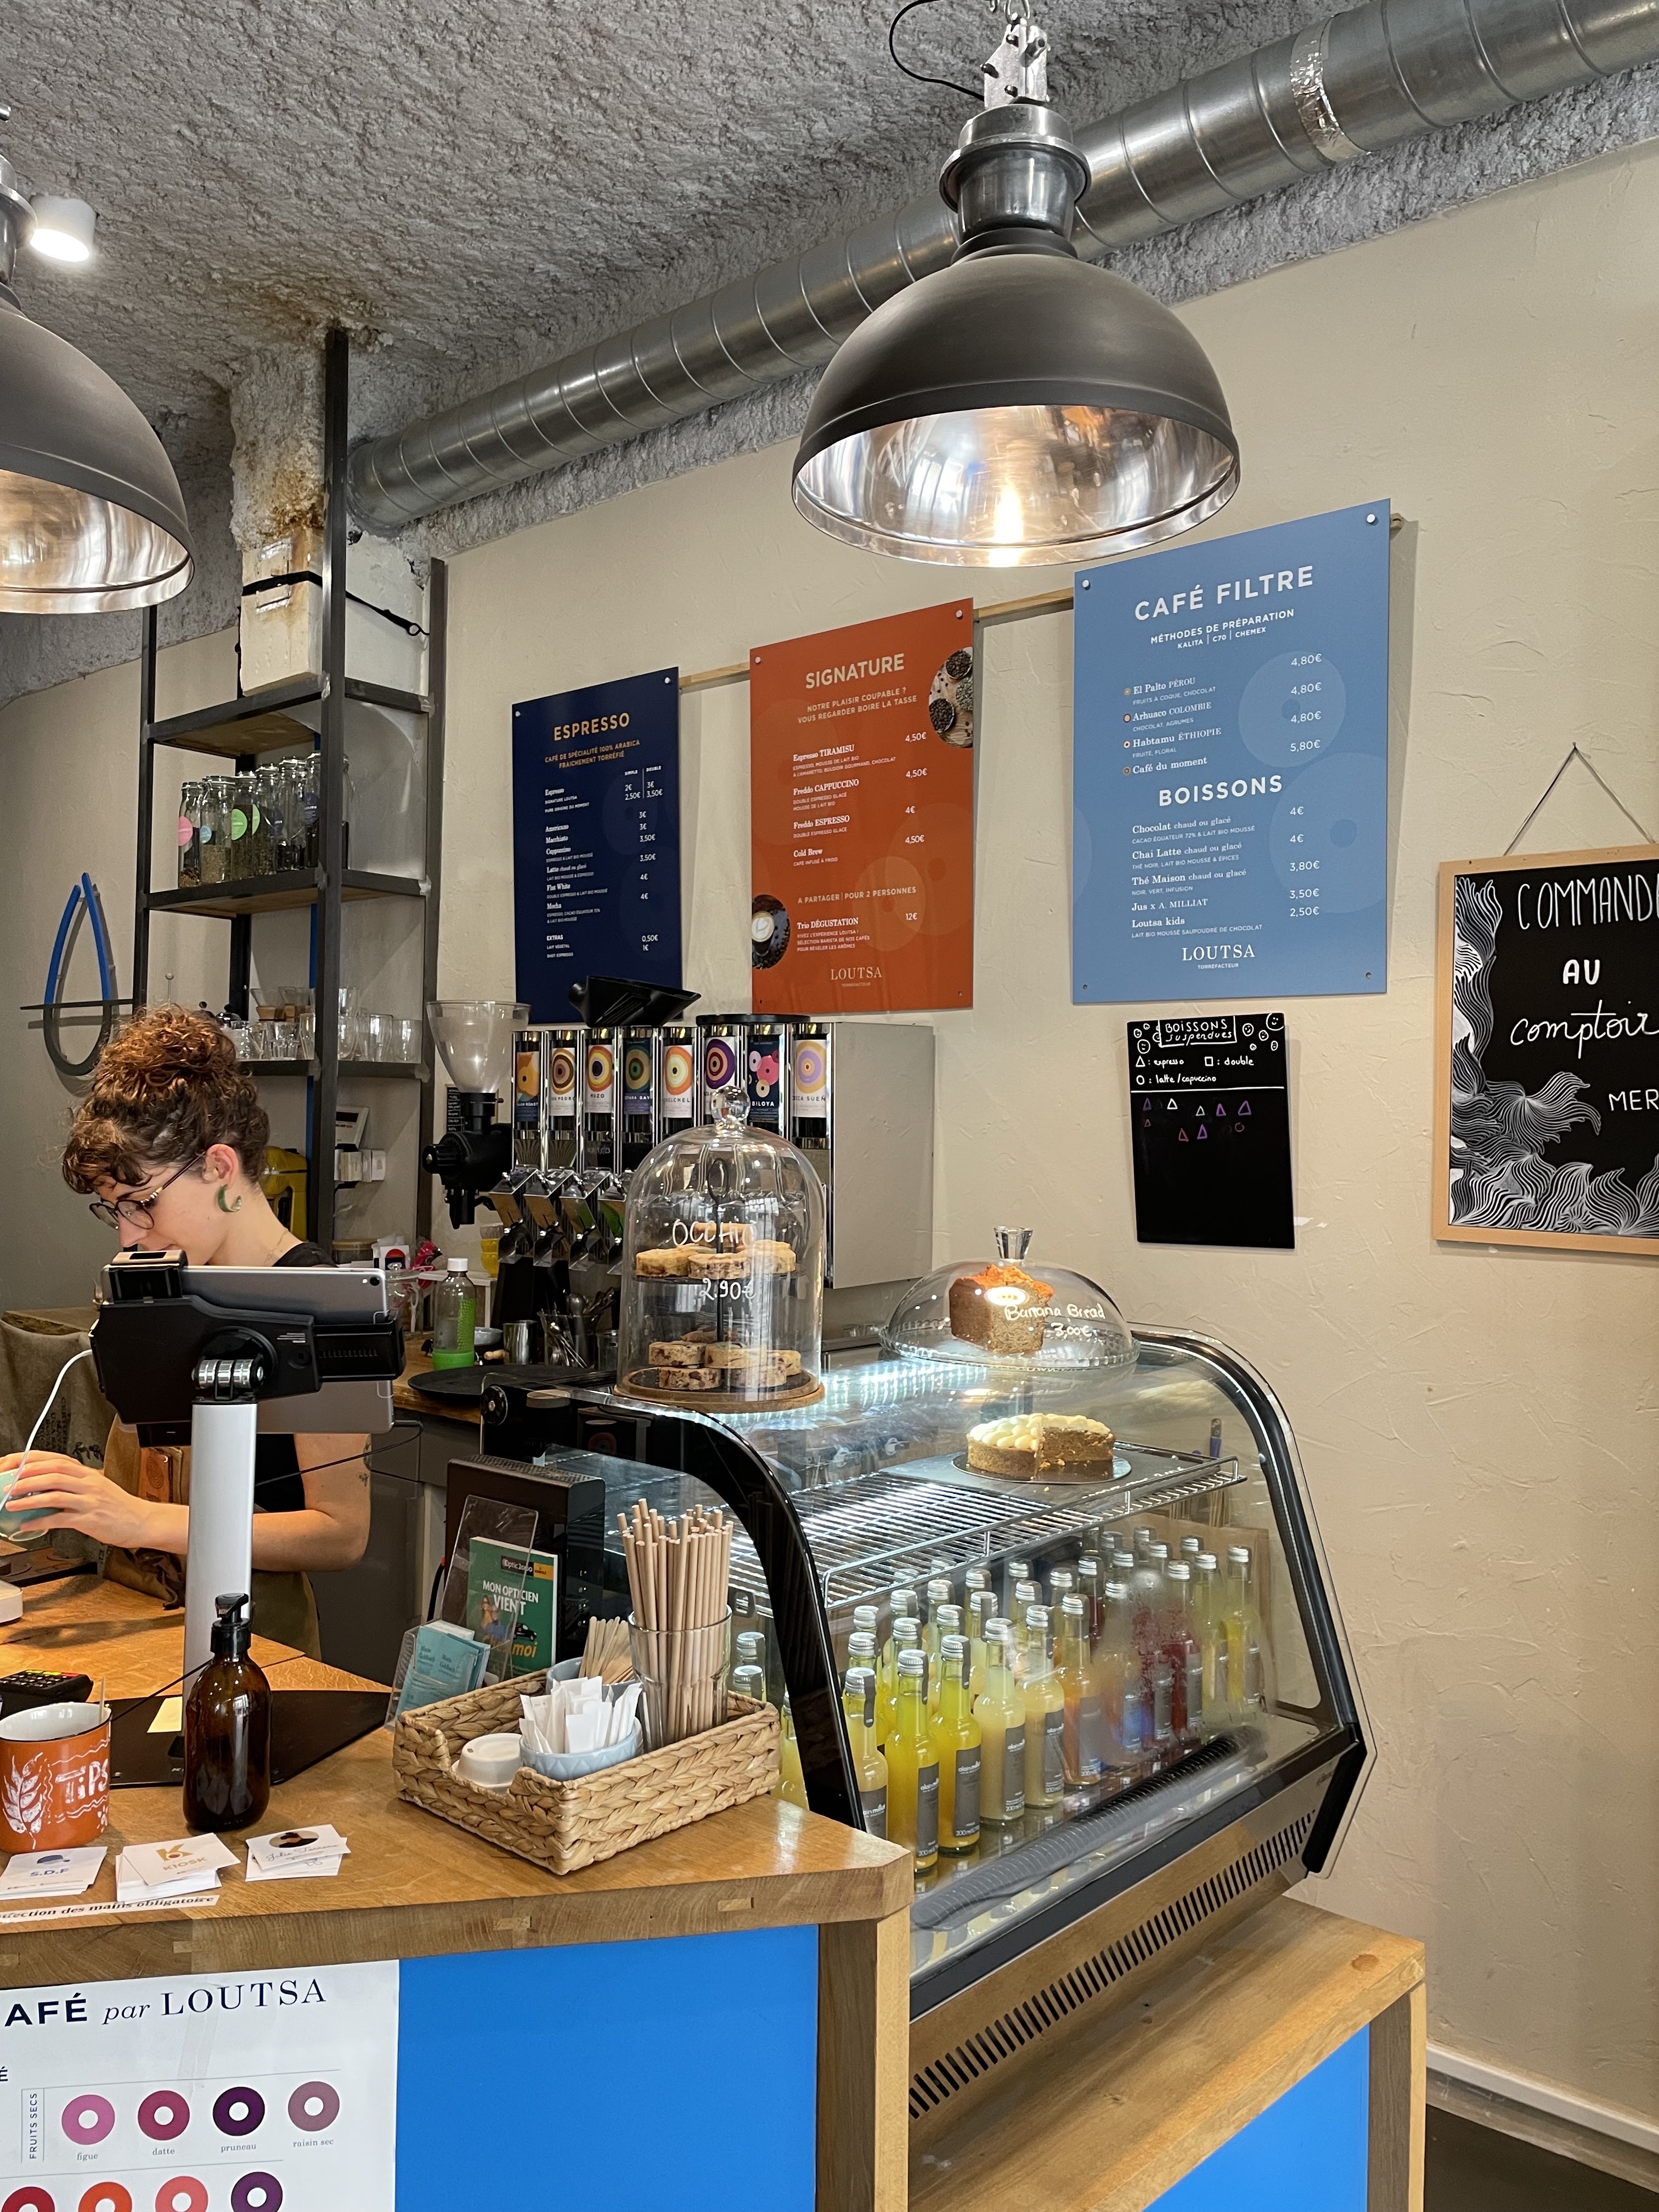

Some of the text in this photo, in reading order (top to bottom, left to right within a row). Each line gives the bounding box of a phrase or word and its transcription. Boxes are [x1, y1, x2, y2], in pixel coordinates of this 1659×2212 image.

[1135, 565, 1313, 620] CAFÉ FILTRE
[1151, 608, 1294, 645] MÉTHODES DE PRÉPARATION
[1177, 626, 1266, 649] KALITA C70 CHEMEX
[805, 653, 904, 689] SIGNATURE
[1133, 653, 1322, 695] El Palto PÉROU 4,80€
[807, 702, 830, 712] NOTRE
[832, 696, 859, 707] PLAISIR
[861, 688, 900, 702] COUPABLE
[1132, 686, 1216, 706] FRUITS CHOCOLAT
[1132, 682, 1322, 721] Arhuaco COLOMBIE 4,80€
[798, 695, 917, 724] VOUS REGARDER BOIRE LA TASSE
[554, 713, 629, 741] ESPRESSO
[1133, 710, 1322, 748] Habtamu ÉTHIOPIE 4,80€
[1166, 717, 1194, 726] AGRUMES
[545, 754, 558, 763] CAFÉ
[568, 746, 598, 759] SPÉCIALITÉ
[614, 739, 640, 749] ARABICA
[819, 732, 927, 757] TIRAMISU 4,50€
[1133, 740, 1321, 774] Café du moment 5,80€
[625, 783, 632, 792] 2€
[793, 768, 927, 795] Freddo CAPPUCCINO 4,50€
[1159, 775, 1282, 806] BOISSONS
[793, 805, 916, 830] Freddo ESPRESSO 4€
[1132, 822, 1171, 834] Chocolat
[1173, 820, 1197, 829] chaud
[1211, 816, 1231, 826] glacé
[1290, 806, 1304, 815] 4€
[1230, 825, 1255, 833] MOUSSÉ
[793, 849, 806, 857] Cold
[905, 834, 924, 844] 4,50€
[1132, 849, 1154, 860] Chai
[1156, 848, 1182, 857] Latte
[1184, 845, 1207, 854] chaud
[1221, 842, 1242, 852] glacé
[1290, 834, 1304, 843] 4€
[1187, 856, 1211, 865] MOUSSÉ
[1131, 876, 1149, 885] Thé
[1152, 874, 1186, 884] Maison
[1188, 872, 1212, 881] chaud
[1226, 868, 1246, 878] glacé
[1290, 860, 1320, 872] 3,80€
[805, 894, 840, 903] PARTAGER
[844, 891, 864, 899] POUR
[872, 886, 916, 897] PERSONNES
[1131, 902, 1148, 911] Jus
[1170, 898, 1208, 908] MILLIAT
[1289, 888, 1319, 900] 3,50€
[1518, 873, 1659, 929] COMMAND
[811, 917, 859, 928] DÉGUSTATION
[905, 912, 917, 921] 12€
[1132, 906, 1319, 928] Loutsa kids 2,50€
[1182, 927, 1218, 935] SAUPOUDRÉ
[1229, 924, 1262, 932] CHOCOLAT
[1182, 944, 1255, 961] LOUTSA
[831, 966, 882, 980] LOUTSA
[1563, 960, 1600, 984] AU
[1510, 1000, 1659, 1059] comptoir
[1154, 1056, 1254, 1069] expresso double
[1609, 1089, 1658, 1111] MER
[1004, 1303, 1105, 1321] Banana Bread
[483, 1580, 539, 1603] MON OPTICIEN
[494, 1594, 526, 1615] VIENT
[512, 1641, 538, 1657] moi
[163, 1857, 207, 1871] KIOSK
[137, 1896, 215, 1909] obligatoire
[5, 1978, 326, 2027] AFÉ par LOUTSA
[29, 2092, 38, 2159] FRUITS SECS
[152, 2147, 175, 2156] datte
[221, 2143, 256, 2153] pruneau
[292, 2138, 334, 2148] raisin sec
[77, 2151, 98, 2162] figue
